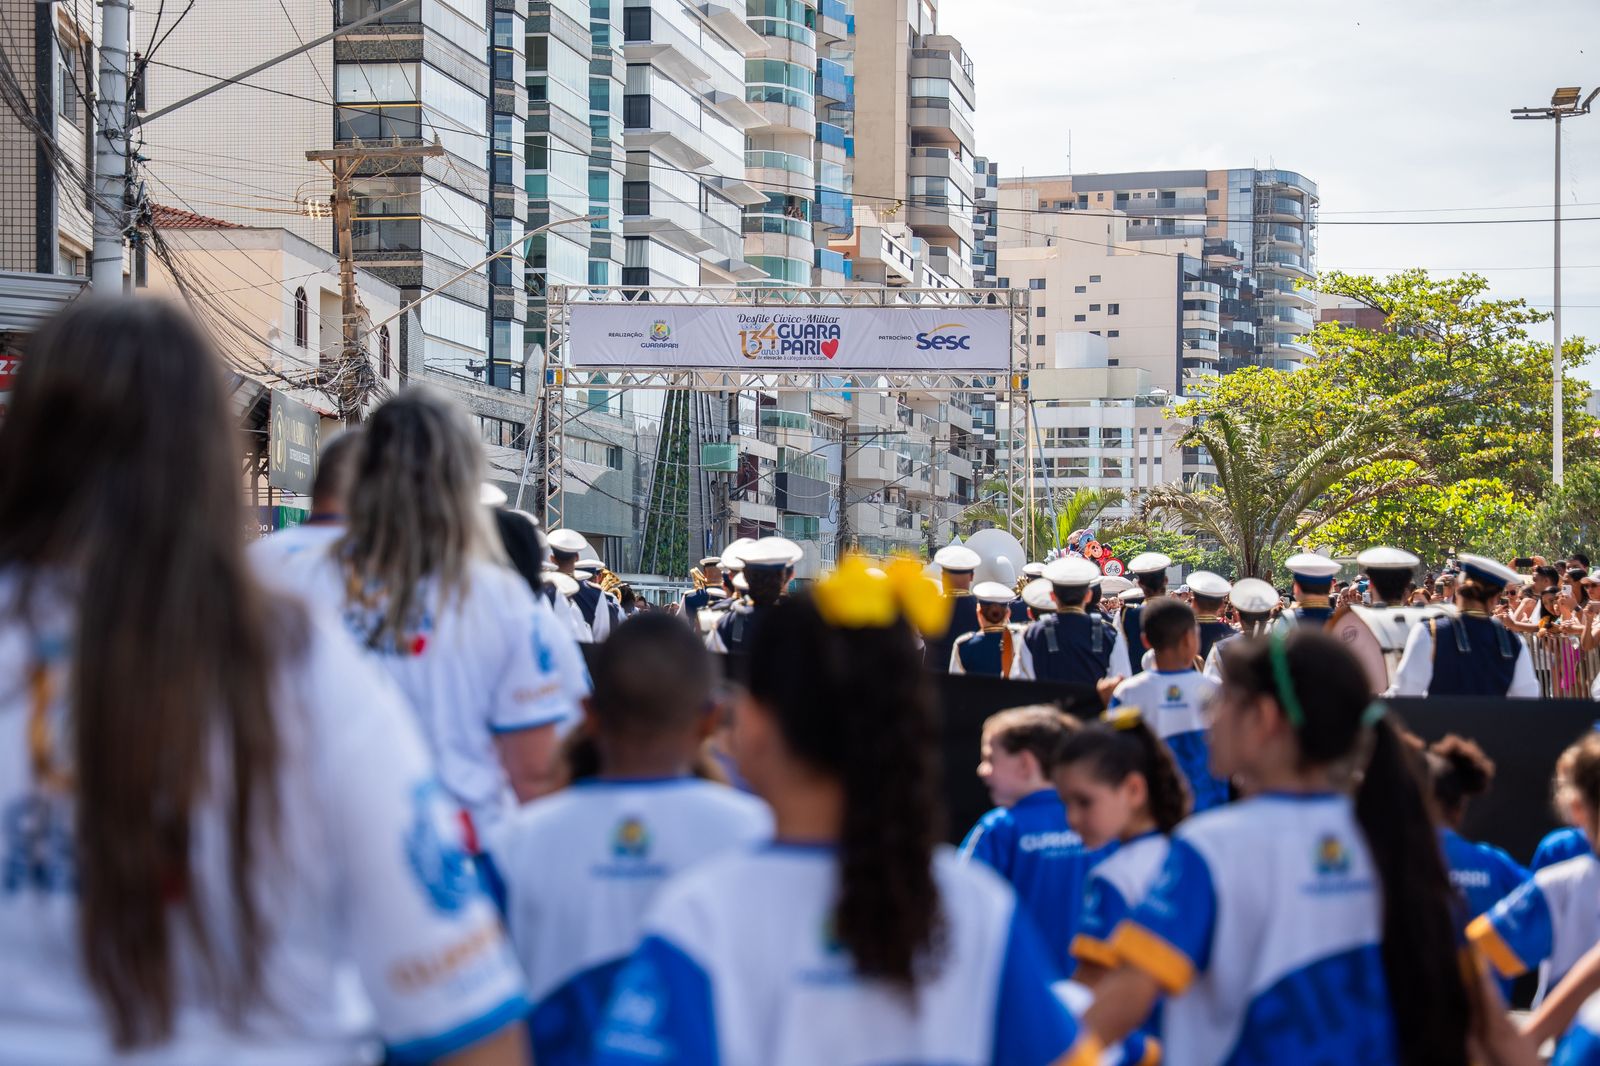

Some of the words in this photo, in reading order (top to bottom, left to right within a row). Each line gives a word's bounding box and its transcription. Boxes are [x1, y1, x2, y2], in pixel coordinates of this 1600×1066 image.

[737, 314, 770, 325] Desfile
[773, 314, 840, 323] Cívico-Militar
[778, 324, 840, 339] GUARA
[781, 340, 820, 355] PARI
[916, 333, 970, 350] Sesc
